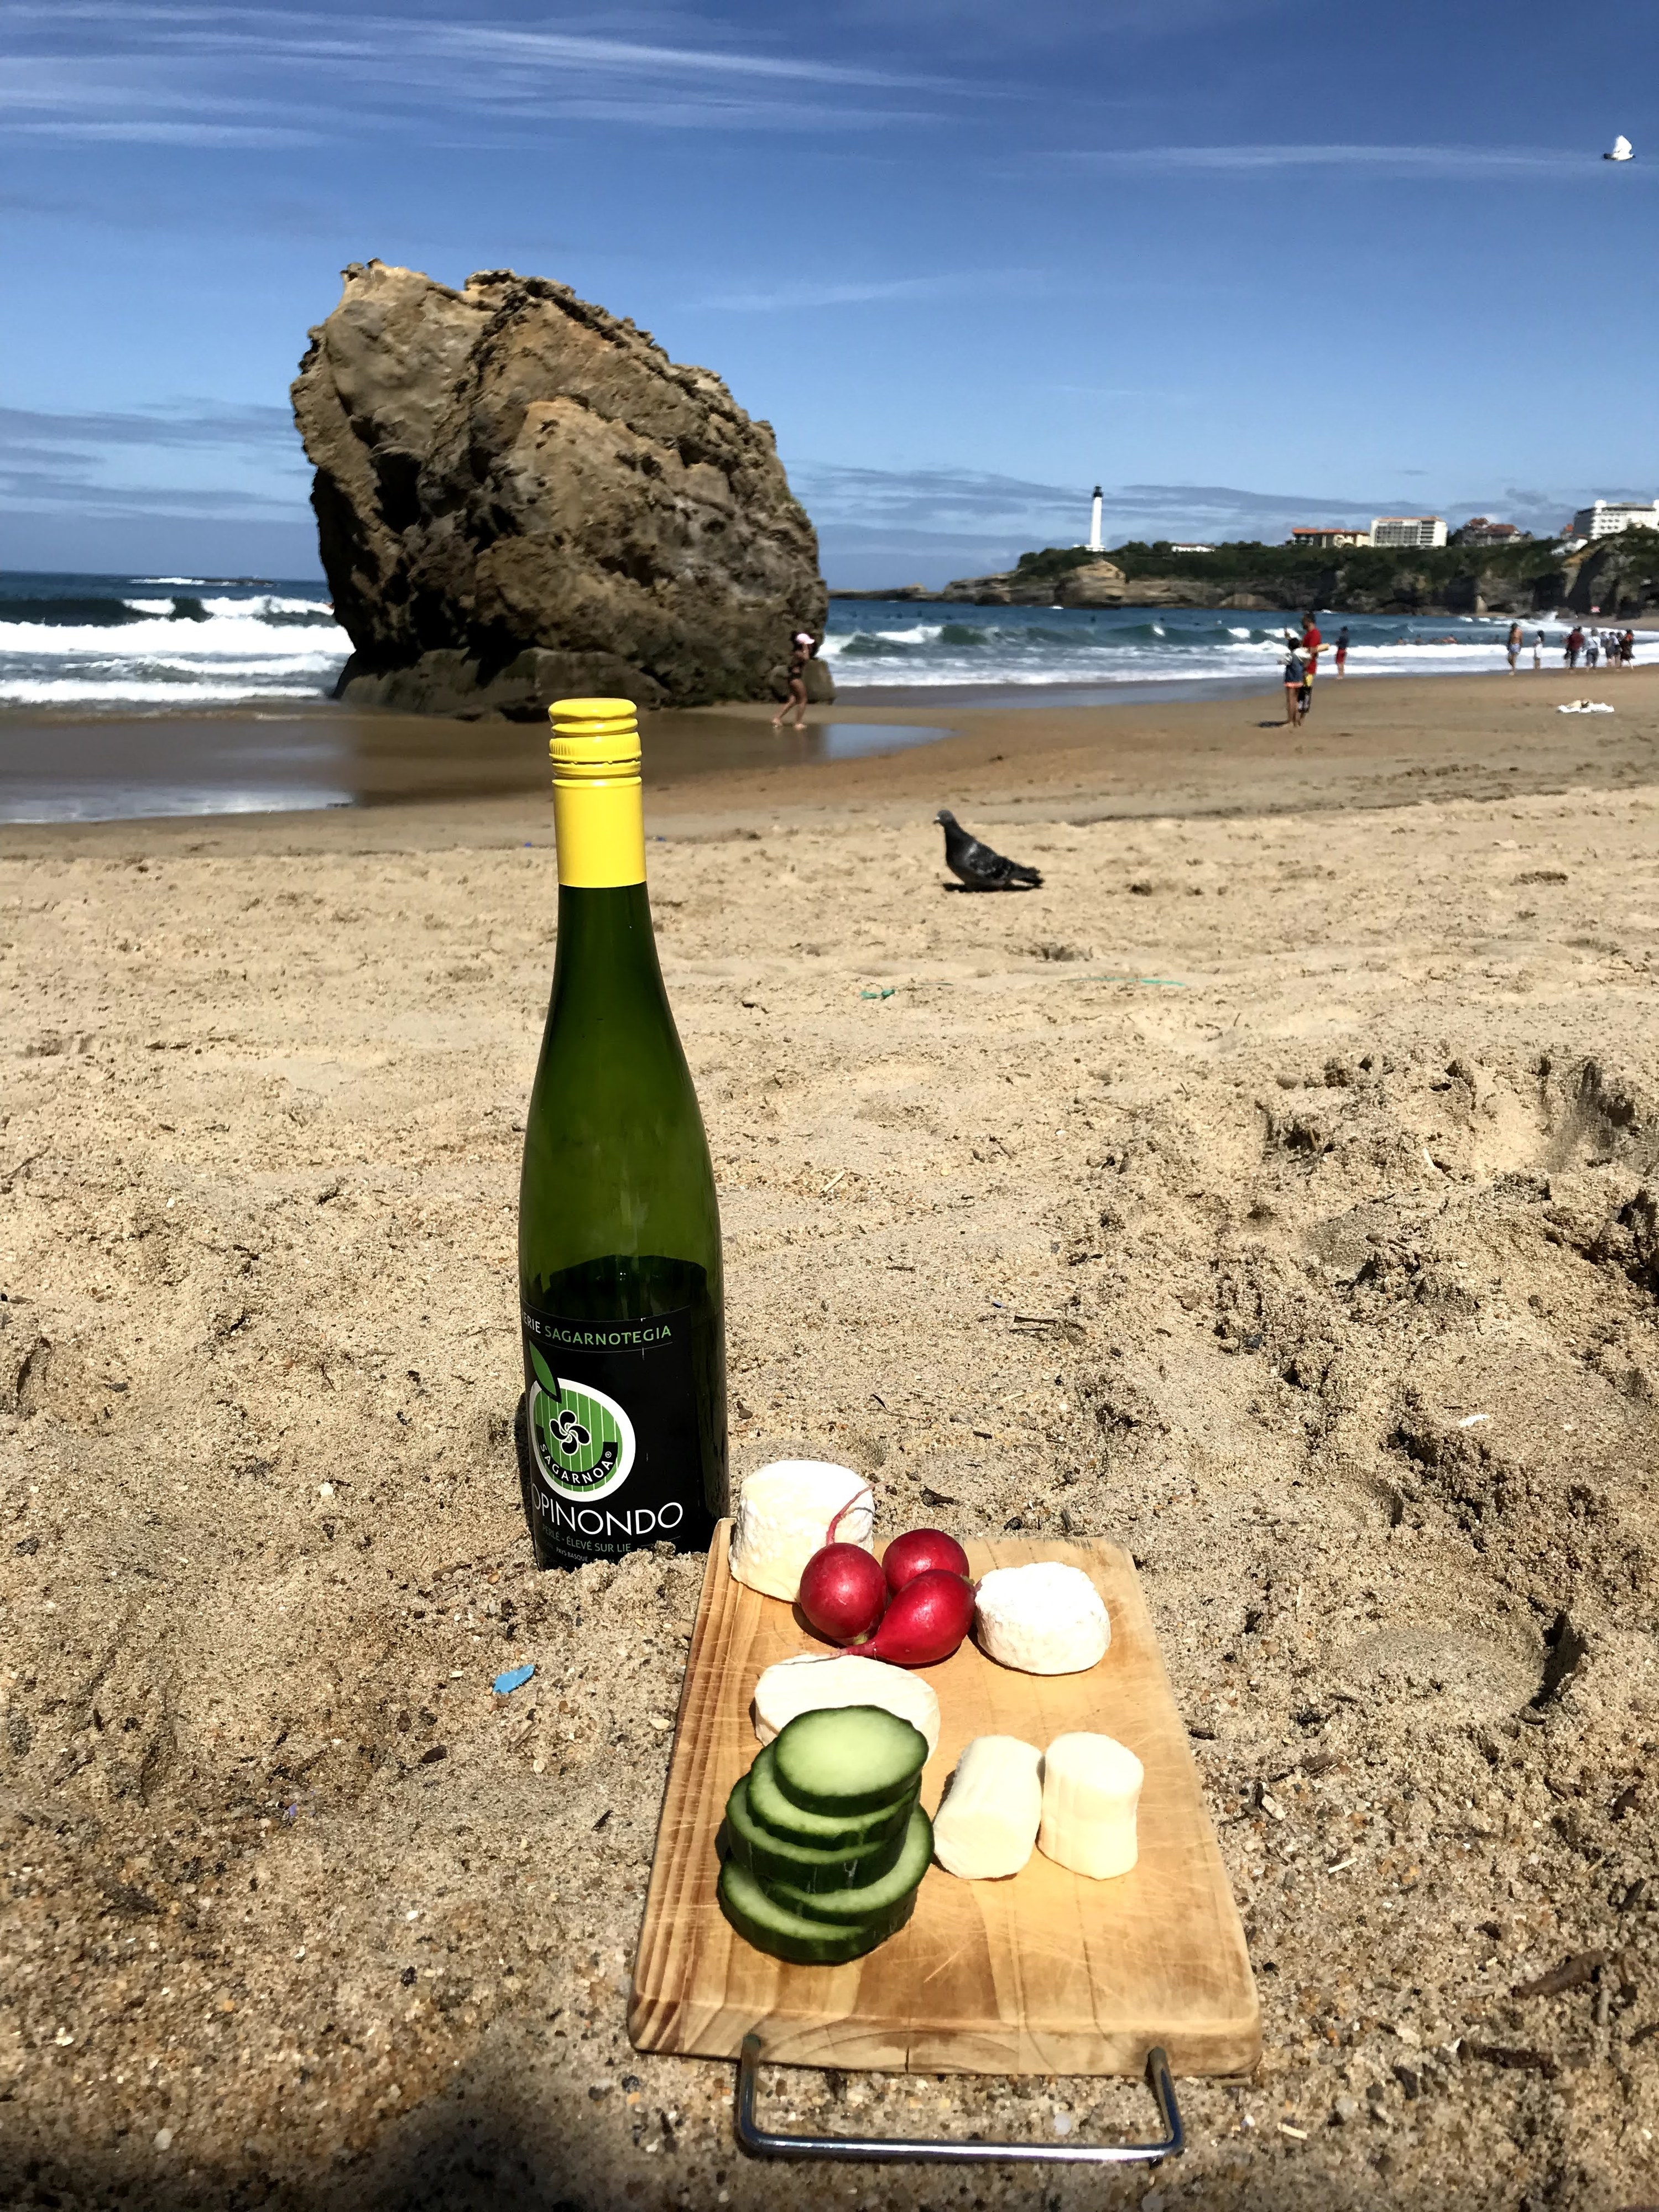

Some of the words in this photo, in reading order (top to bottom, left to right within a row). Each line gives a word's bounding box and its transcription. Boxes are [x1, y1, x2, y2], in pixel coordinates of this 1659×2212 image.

[545, 1325, 671, 1345] SAGARNOTEGIA
[566, 1536, 592, 1551] ÉLEVÉ
[594, 1543, 614, 1552] SUR
[617, 1543, 632, 1552] LIE
[556, 1547, 567, 1556] PAYS
[568, 1552, 588, 1562] BASQUE
